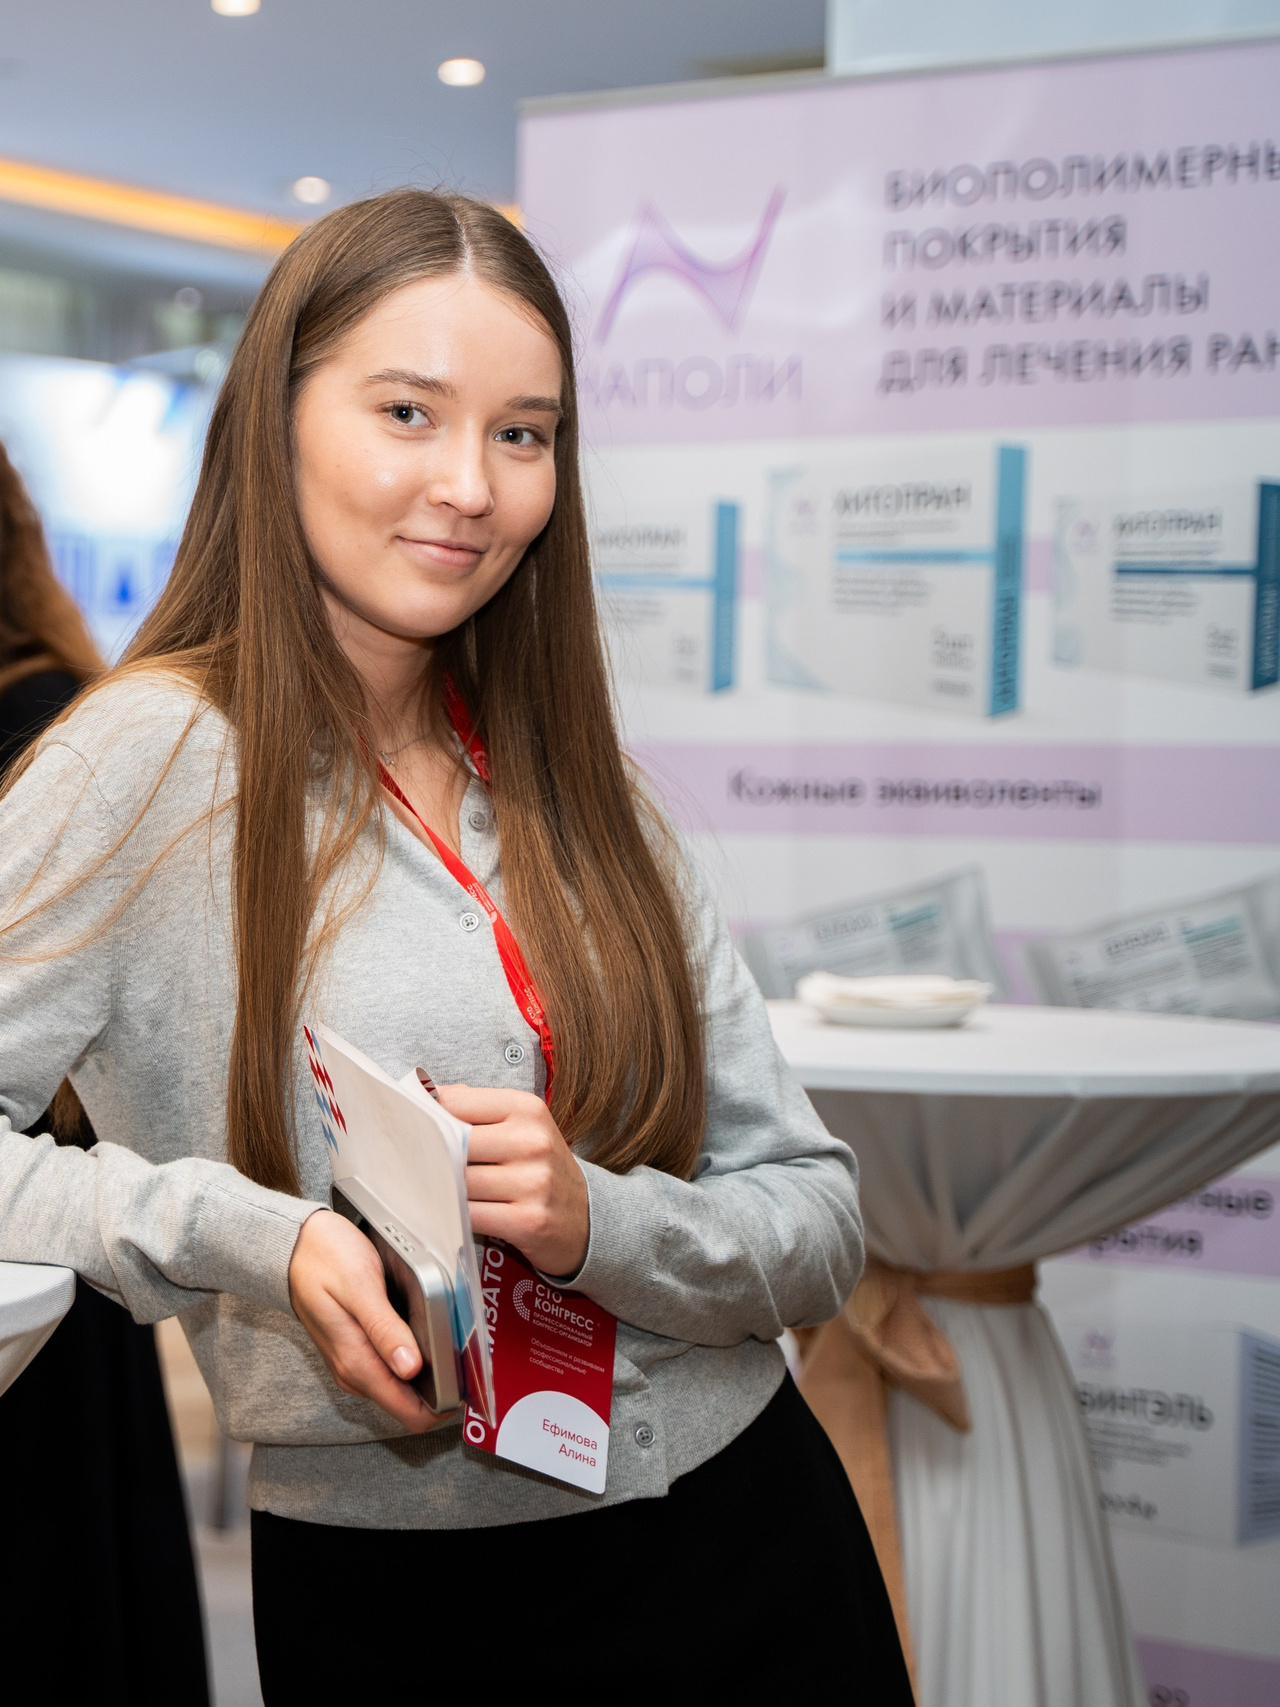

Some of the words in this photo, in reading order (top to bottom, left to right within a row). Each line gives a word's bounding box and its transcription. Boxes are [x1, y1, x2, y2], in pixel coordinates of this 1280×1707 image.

[883, 214, 1127, 272] ПОКРЫТИЯ
[881, 290, 916, 330] И
[924, 273, 1209, 325] МАТЕРИАЛЫ
[877, 347, 967, 394] ДЛЯ
[981, 333, 1192, 388] ЛЕЧЕНИЯ
[535, 1284, 562, 1303] СТО
[533, 1311, 593, 1341] ПРОФЕССИОНАЛЬНЫЙ
[534, 1297, 594, 1331] КОНГРЕСС
[532, 1319, 593, 1348] КОНГРЕСС-ОРГАНИЗАТОР
[529, 1356, 565, 1375] сообщества
[530, 1337, 568, 1358] Объединяем
[573, 1356, 605, 1373] развиваем
[530, 1347, 587, 1375] профессиональные
[542, 1418, 598, 1450] Ефимова
[558, 1443, 596, 1467] Алина
